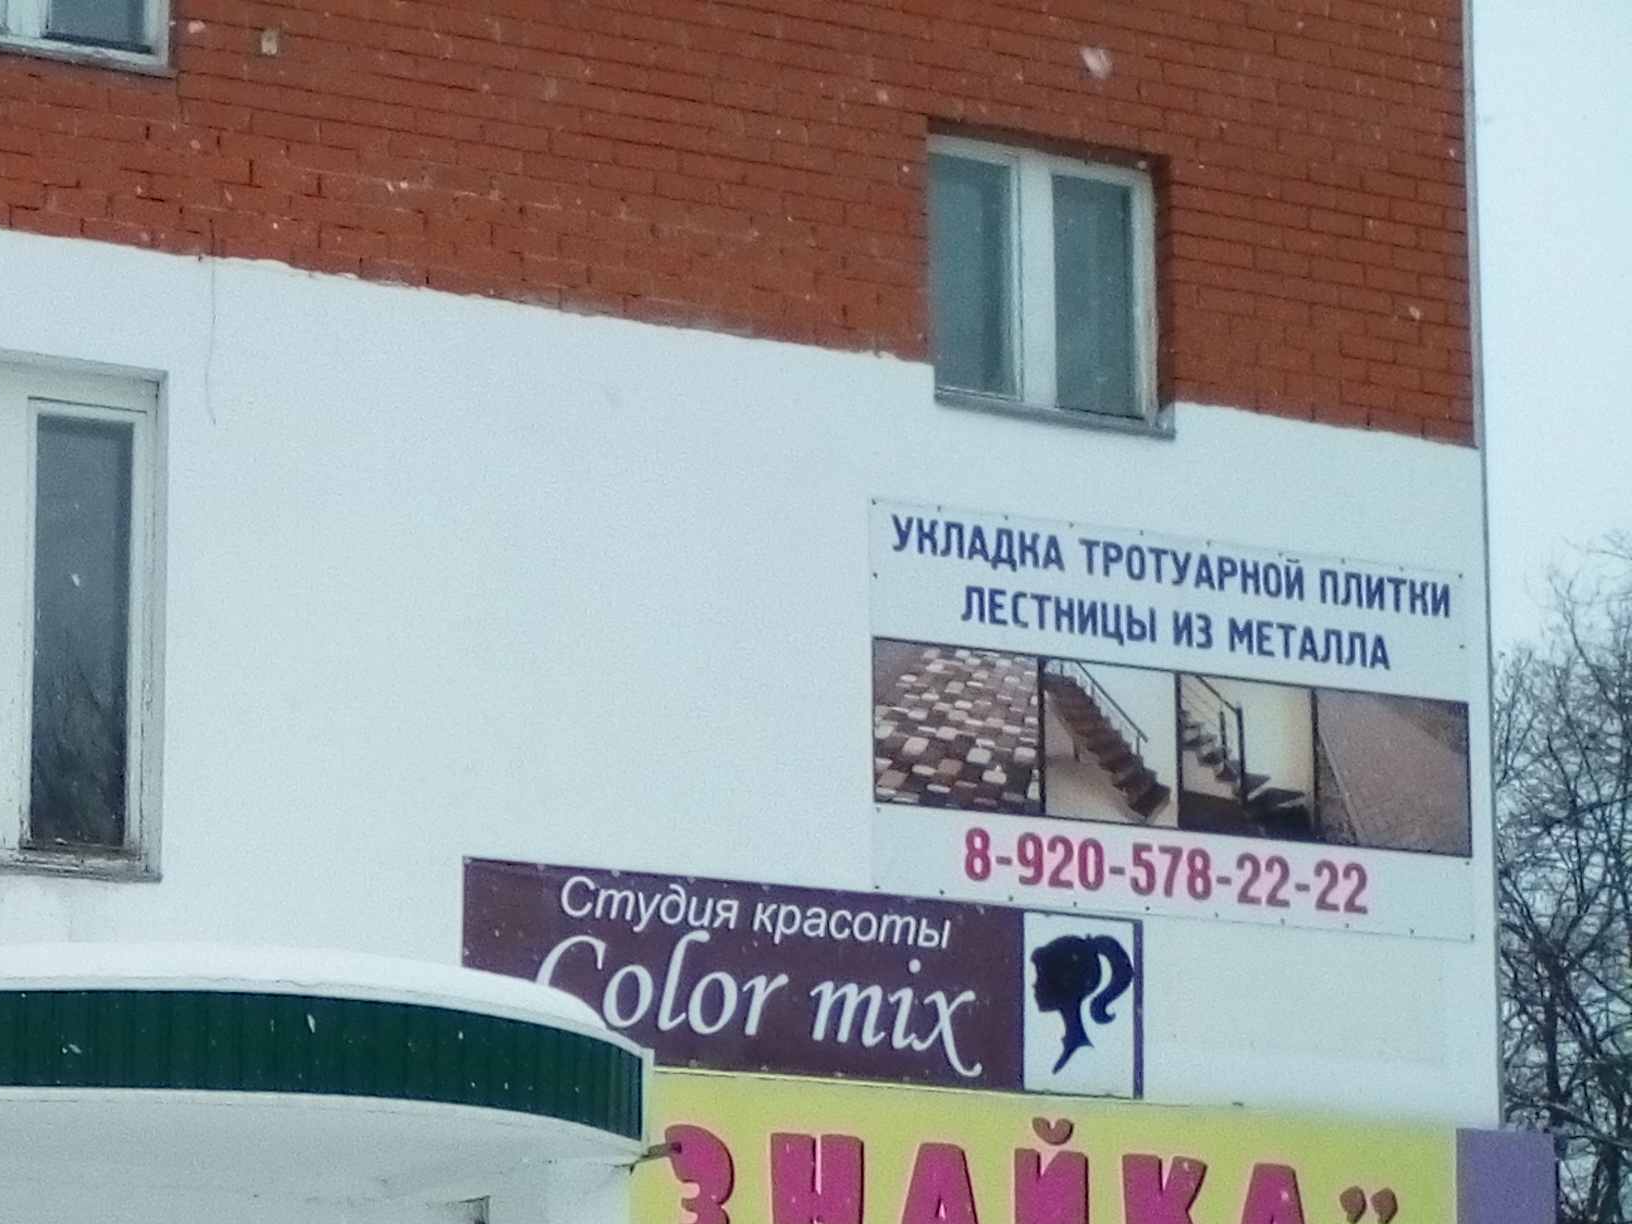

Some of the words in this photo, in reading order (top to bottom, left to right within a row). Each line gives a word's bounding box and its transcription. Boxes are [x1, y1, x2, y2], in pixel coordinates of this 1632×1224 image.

[891, 514, 1065, 572] УКЛАДКА
[1079, 537, 1305, 602] ТРОТУАРНОЙ
[1319, 569, 1452, 619] ПЛИТКИ
[961, 586, 1157, 646] ЛЕСТНИЦЫ
[1172, 611, 1214, 650] ИЗ
[1229, 619, 1391, 671] МЕТАЛЛА
[560, 876, 740, 934] Студия
[752, 900, 951, 950] красоты
[964, 827, 1369, 914] 8-920-578-22-22
[534, 930, 789, 1036] Color
[810, 958, 982, 1077] mix
